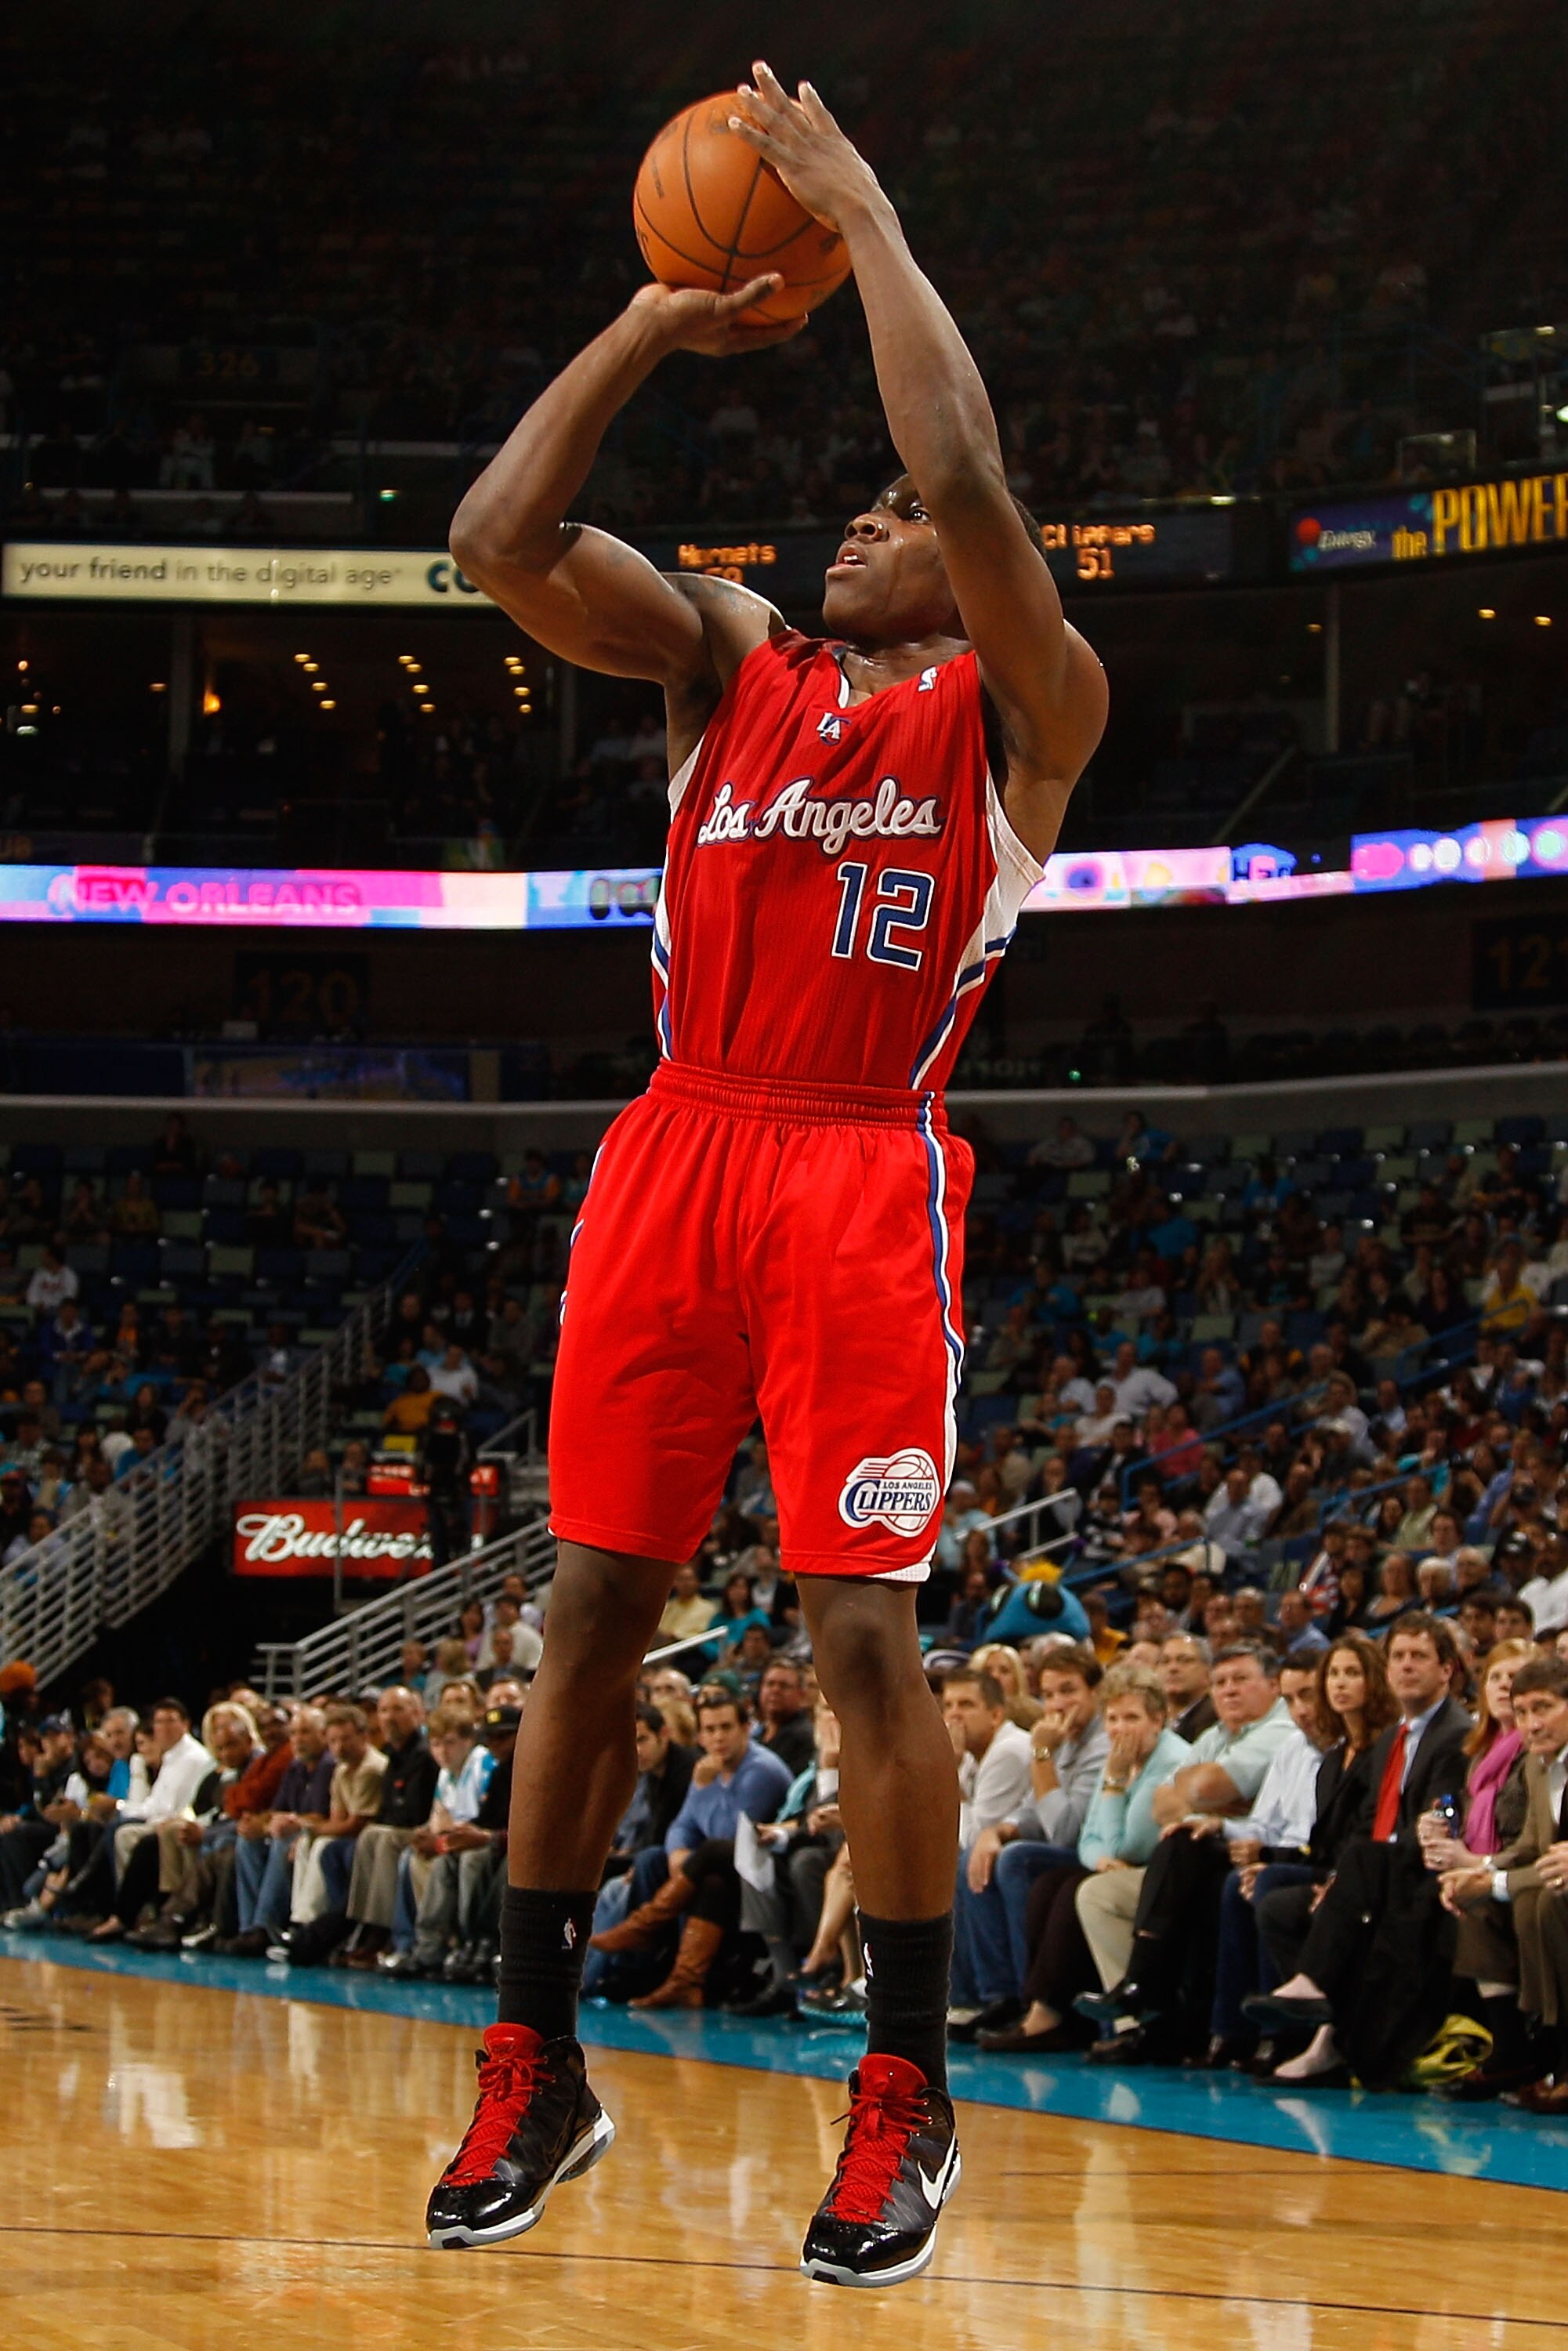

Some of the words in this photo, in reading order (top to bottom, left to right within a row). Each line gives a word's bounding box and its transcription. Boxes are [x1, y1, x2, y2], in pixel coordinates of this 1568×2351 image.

[1391, 525, 1429, 560] the
[20, 562, 80, 584] your
[89, 556, 168, 581] friend
[175, 558, 197, 581] in
[207, 559, 248, 581] the
[1077, 547, 1115, 580] 51
[697, 781, 753, 847] Los
[755, 776, 942, 855] Angeles
[166, 882, 361, 915] ORLEANS
[831, 861, 936, 972] 12
[246, 968, 359, 1024] 120
[845, 1479, 932, 1522] CLIPPERS
[883, 1481, 900, 1490] LOS
[901, 1481, 932, 1491] ANGELES
